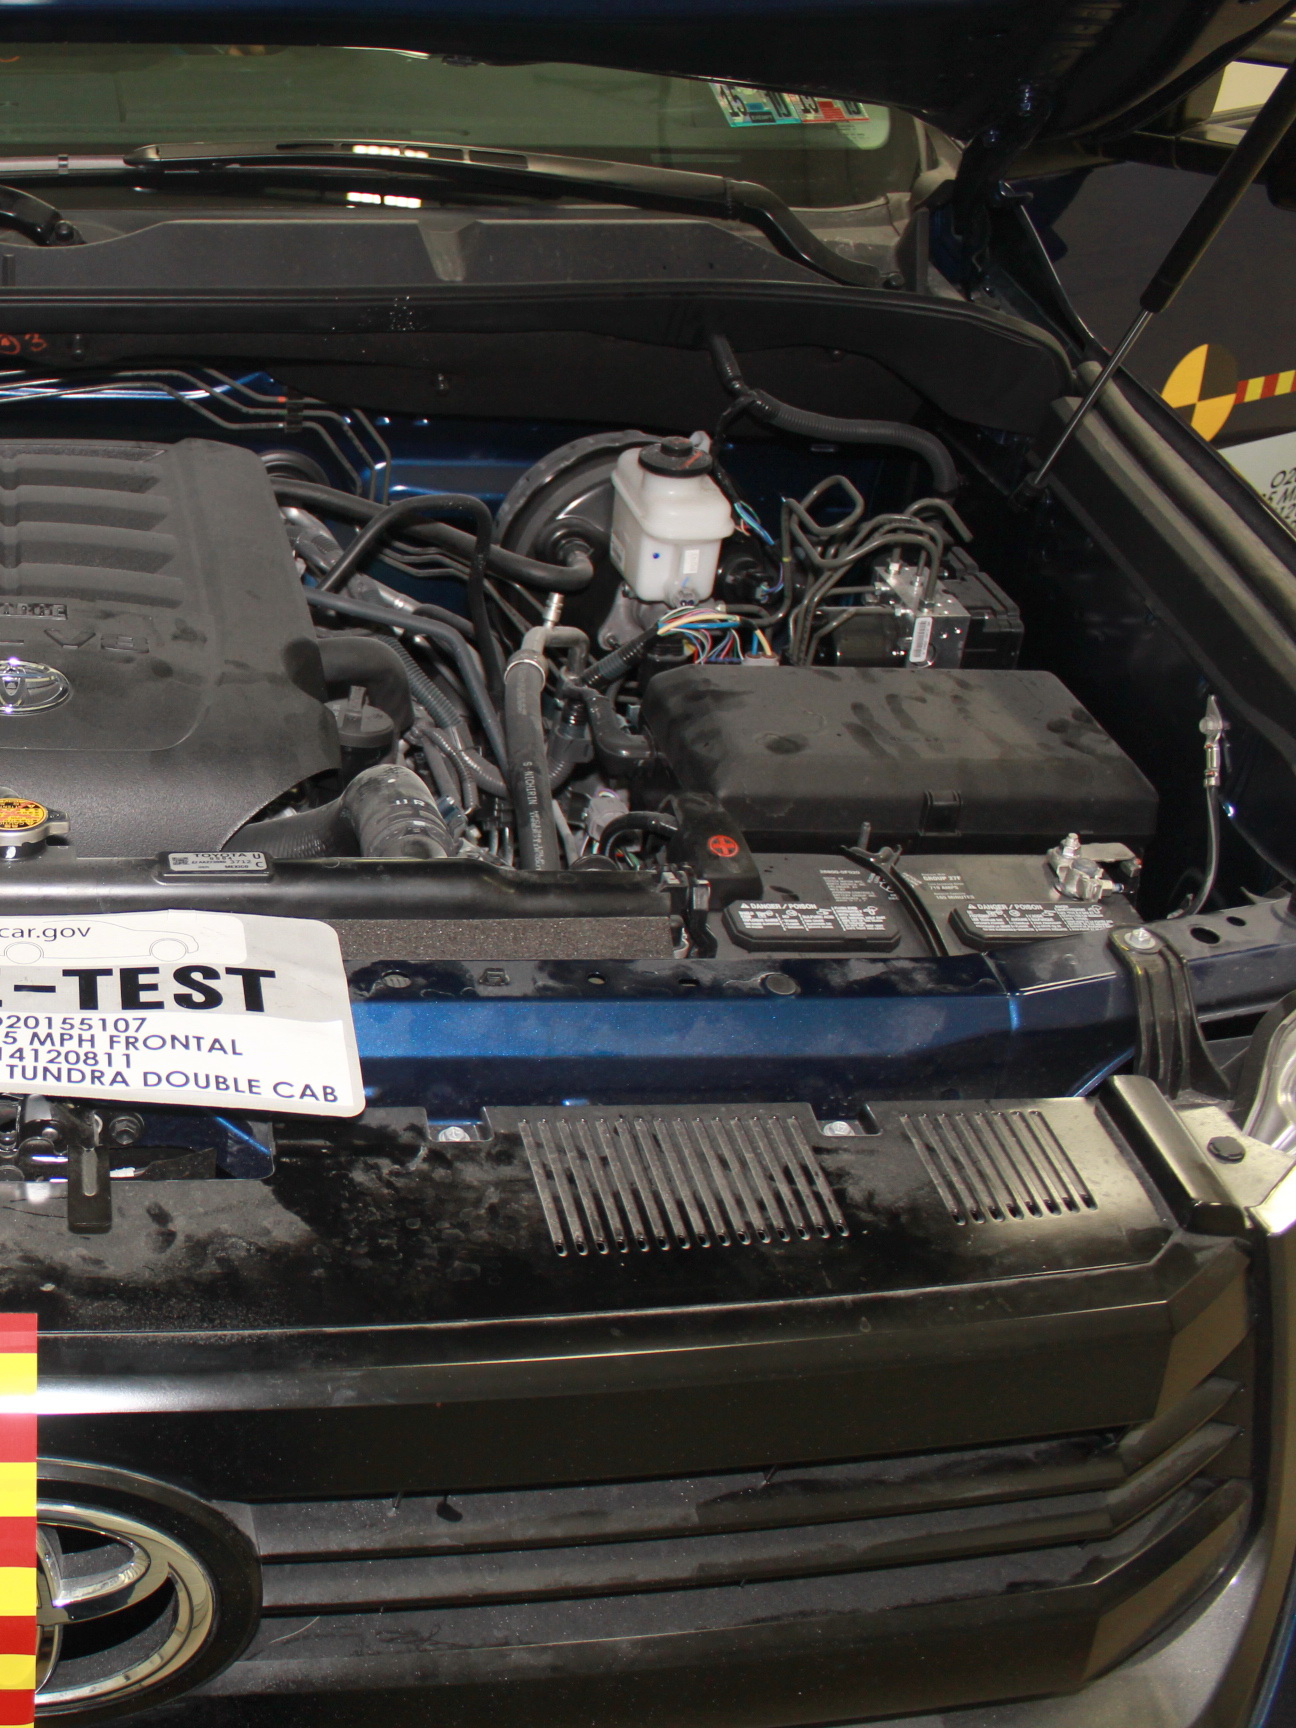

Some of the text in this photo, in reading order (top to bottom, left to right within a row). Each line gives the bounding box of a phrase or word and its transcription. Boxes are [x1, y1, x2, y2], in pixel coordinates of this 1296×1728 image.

[29, 1031, 96, 1050] MPH
[108, 1033, 244, 1057] FRONTAL
[7, 1064, 131, 1088] TUNDRA
[142, 1071, 262, 1096] DOUBLE
[272, 1081, 339, 1103] CAB
